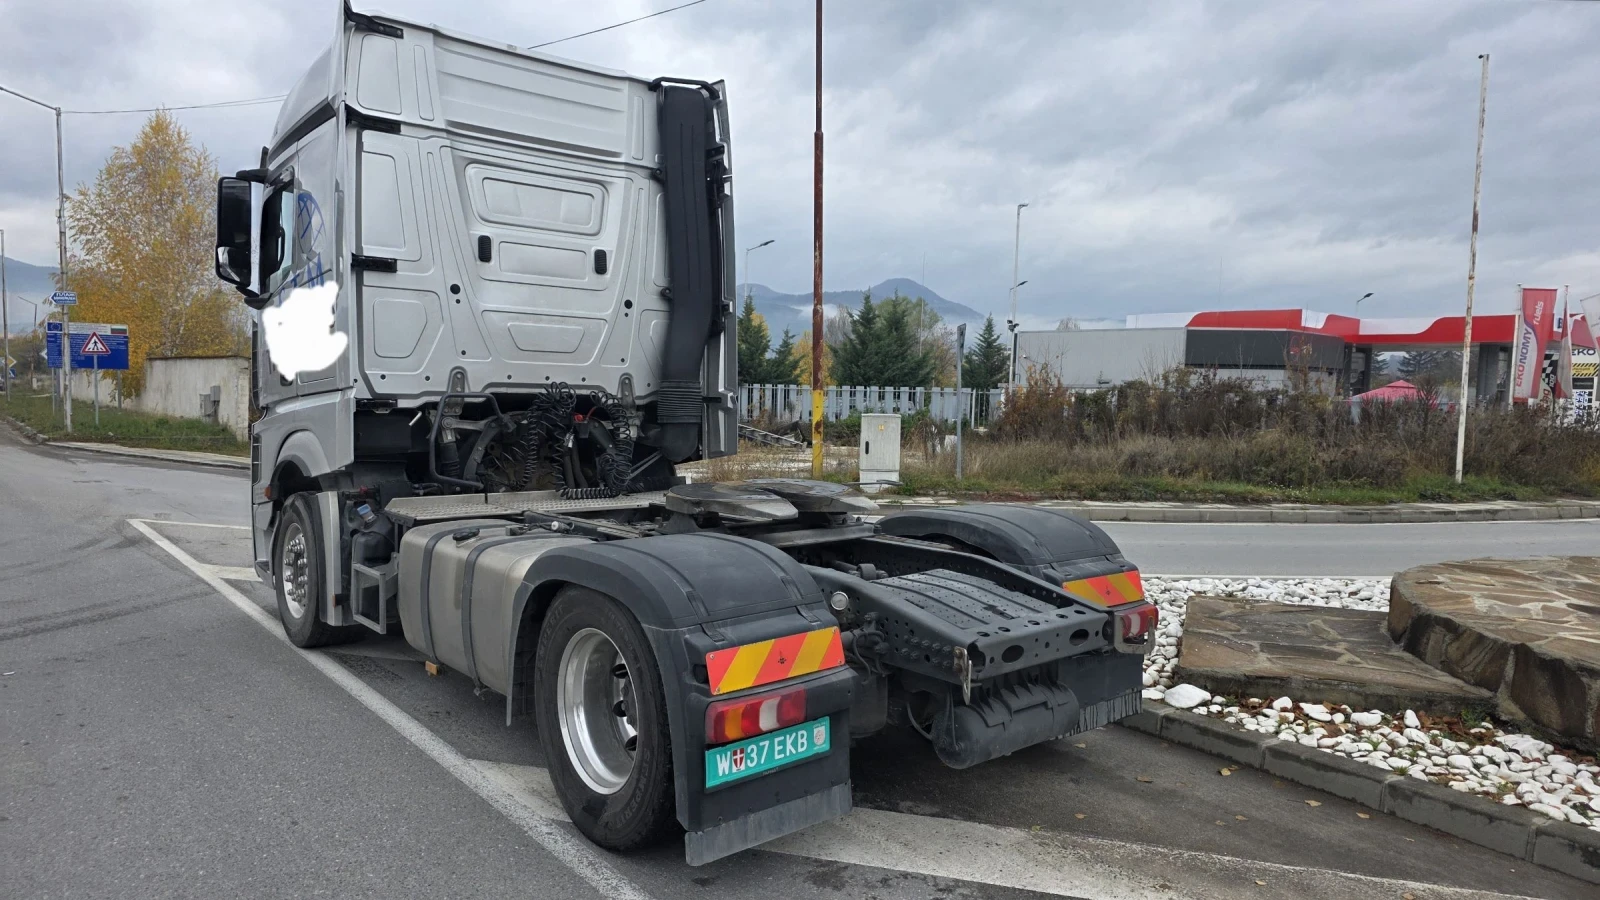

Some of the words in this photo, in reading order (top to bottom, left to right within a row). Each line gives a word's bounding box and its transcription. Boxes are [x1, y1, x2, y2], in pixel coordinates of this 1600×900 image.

[1533, 301, 1544, 325] fuels
[1516, 328, 1532, 387] EKONOMY
[716, 750, 731, 777] W
[747, 740, 770, 768] 37
[774, 730, 808, 760] EKB
